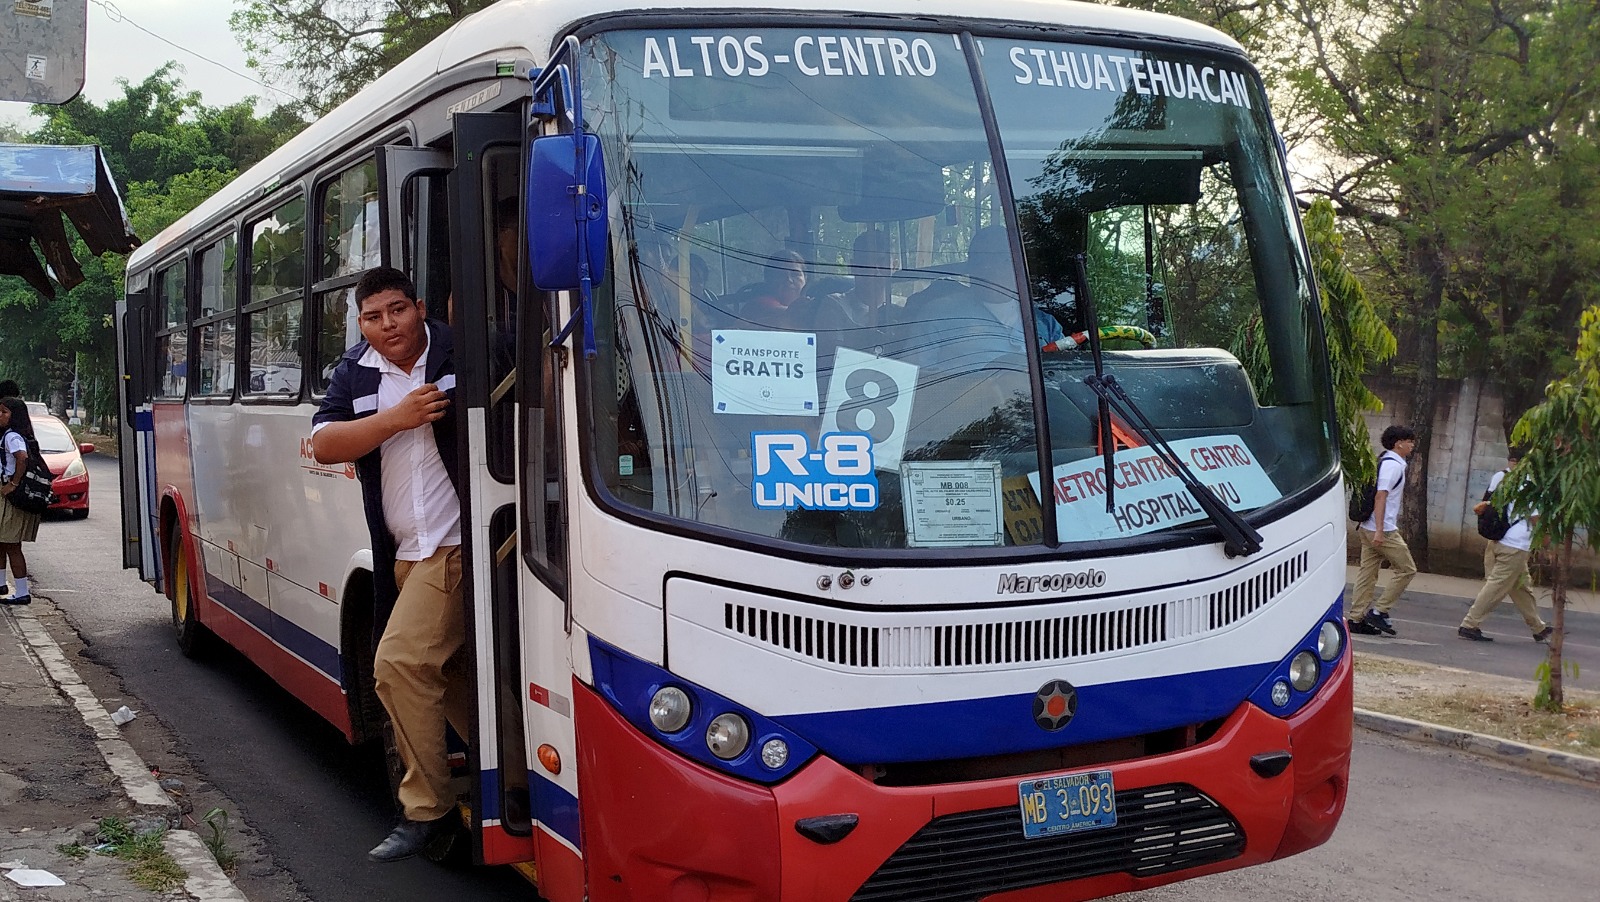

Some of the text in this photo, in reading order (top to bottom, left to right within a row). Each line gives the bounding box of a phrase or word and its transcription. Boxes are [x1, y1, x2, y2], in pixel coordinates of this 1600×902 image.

[643, 36, 1252, 110] ALTOS-CENTRO SIHUATEHUACAN
[730, 347, 800, 359] TRANSPORTE
[725, 359, 804, 379] GRATIS
[835, 368, 899, 444] 8
[755, 434, 872, 476] R-8
[1190, 444, 1252, 472] CENTRO
[755, 482, 876, 507] UNICO
[940, 481, 953, 489] MB
[945, 498, 966, 506] $0.25
[1112, 481, 1241, 532] HOSPITAL VU
[997, 569, 1107, 594] Marcopolo
[1043, 776, 1089, 790] EL SALVADOR
[1023, 793, 1047, 823] MB
[1047, 821, 1096, 832] CENTRO AMERICA
